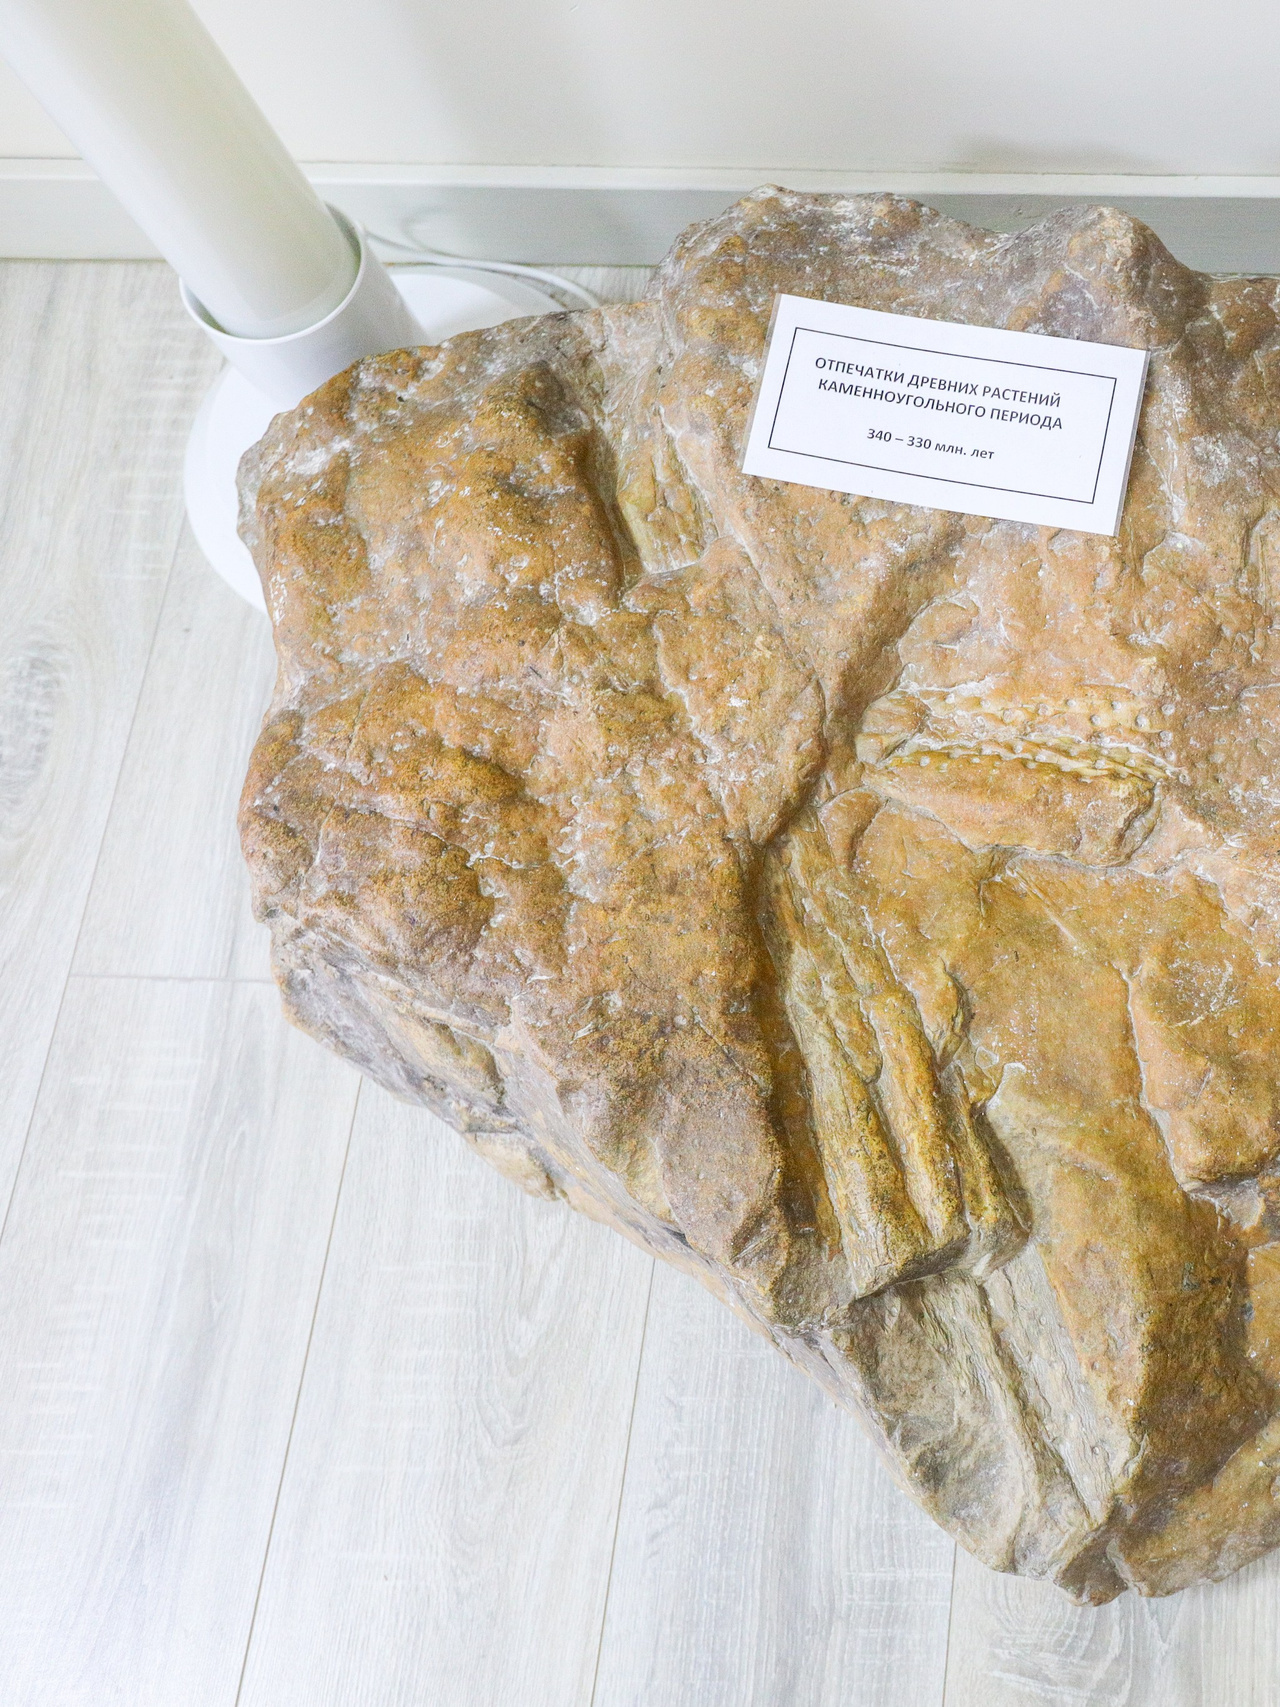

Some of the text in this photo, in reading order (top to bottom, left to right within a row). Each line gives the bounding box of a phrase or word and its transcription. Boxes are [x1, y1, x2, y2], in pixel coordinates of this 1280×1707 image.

[815, 357, 1061, 408] ОТПЕЧАТКИ ДРЕВНИХ РАСТЕНИЙ
[818, 378, 1063, 431] КАМЕННОУГОЛЬНОГО ПЕРИОДА
[867, 428, 892, 443] 340
[906, 436, 932, 450] 330
[934, 443, 967, 456] млн.
[970, 448, 995, 460] лет
